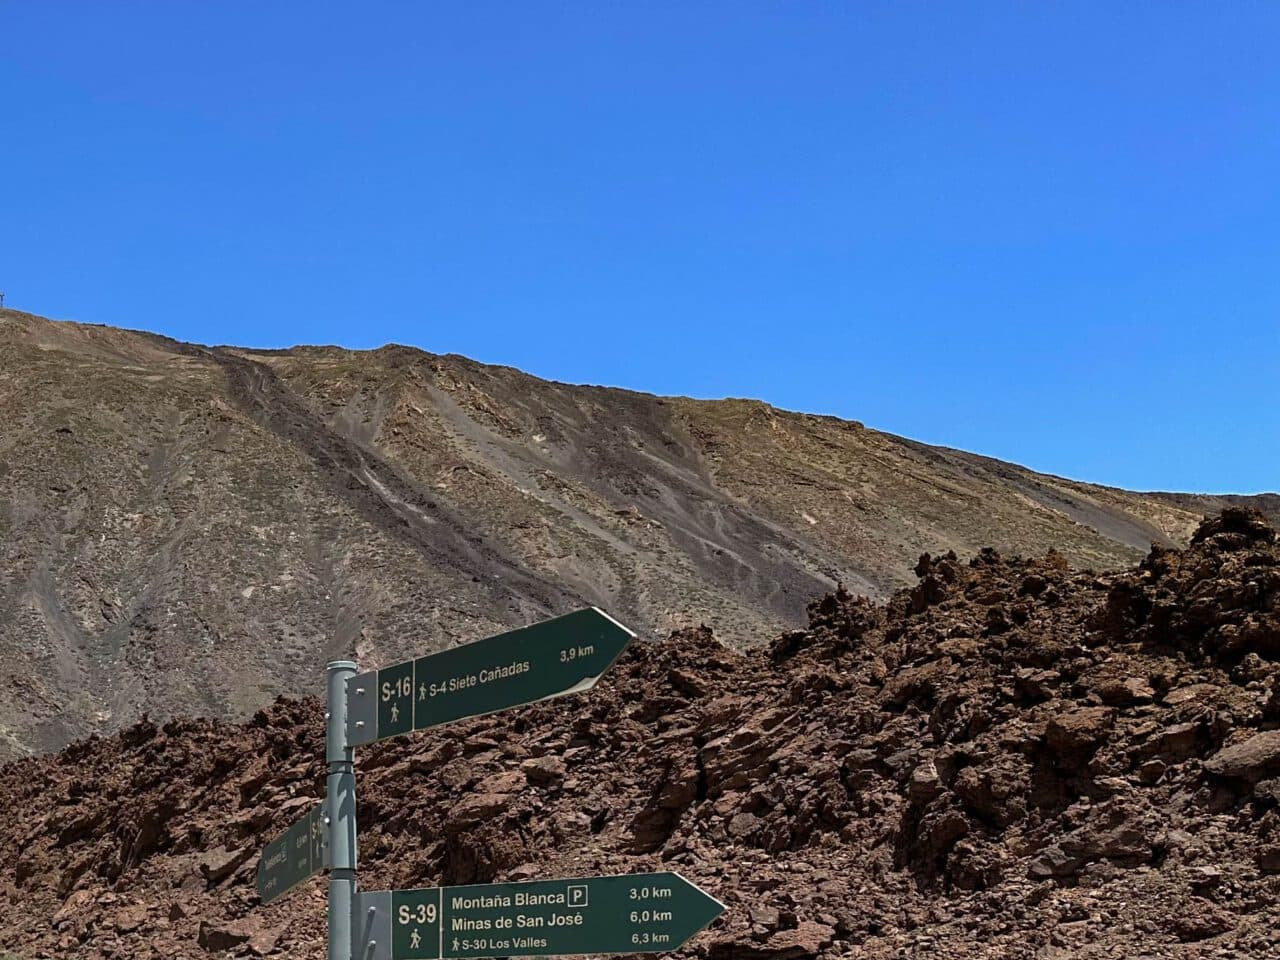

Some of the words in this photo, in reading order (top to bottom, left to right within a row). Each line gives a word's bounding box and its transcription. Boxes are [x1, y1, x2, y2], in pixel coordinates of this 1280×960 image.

[559, 648, 577, 663] 3,9
[578, 644, 594, 658] km
[429, 683, 447, 697] S-4
[449, 674, 477, 692] Siete
[479, 659, 530, 684] Cañadas
[381, 676, 412, 702] S-16
[451, 894, 512, 910] Montaña
[515, 891, 565, 906] Blanca
[629, 887, 649, 900] 3,0
[652, 887, 672, 898] km
[398, 903, 437, 924] S-39
[451, 916, 492, 932] Minas
[495, 915, 512, 929] de
[516, 914, 544, 928] San
[547, 911, 583, 926] José
[629, 910, 650, 924] 6,0
[653, 909, 672, 921] km
[462, 938, 487, 950] S-30
[490, 938, 510, 949] Los
[512, 937, 547, 949] Valles
[631, 933, 649, 945] 6,3
[651, 932, 670, 943] km
